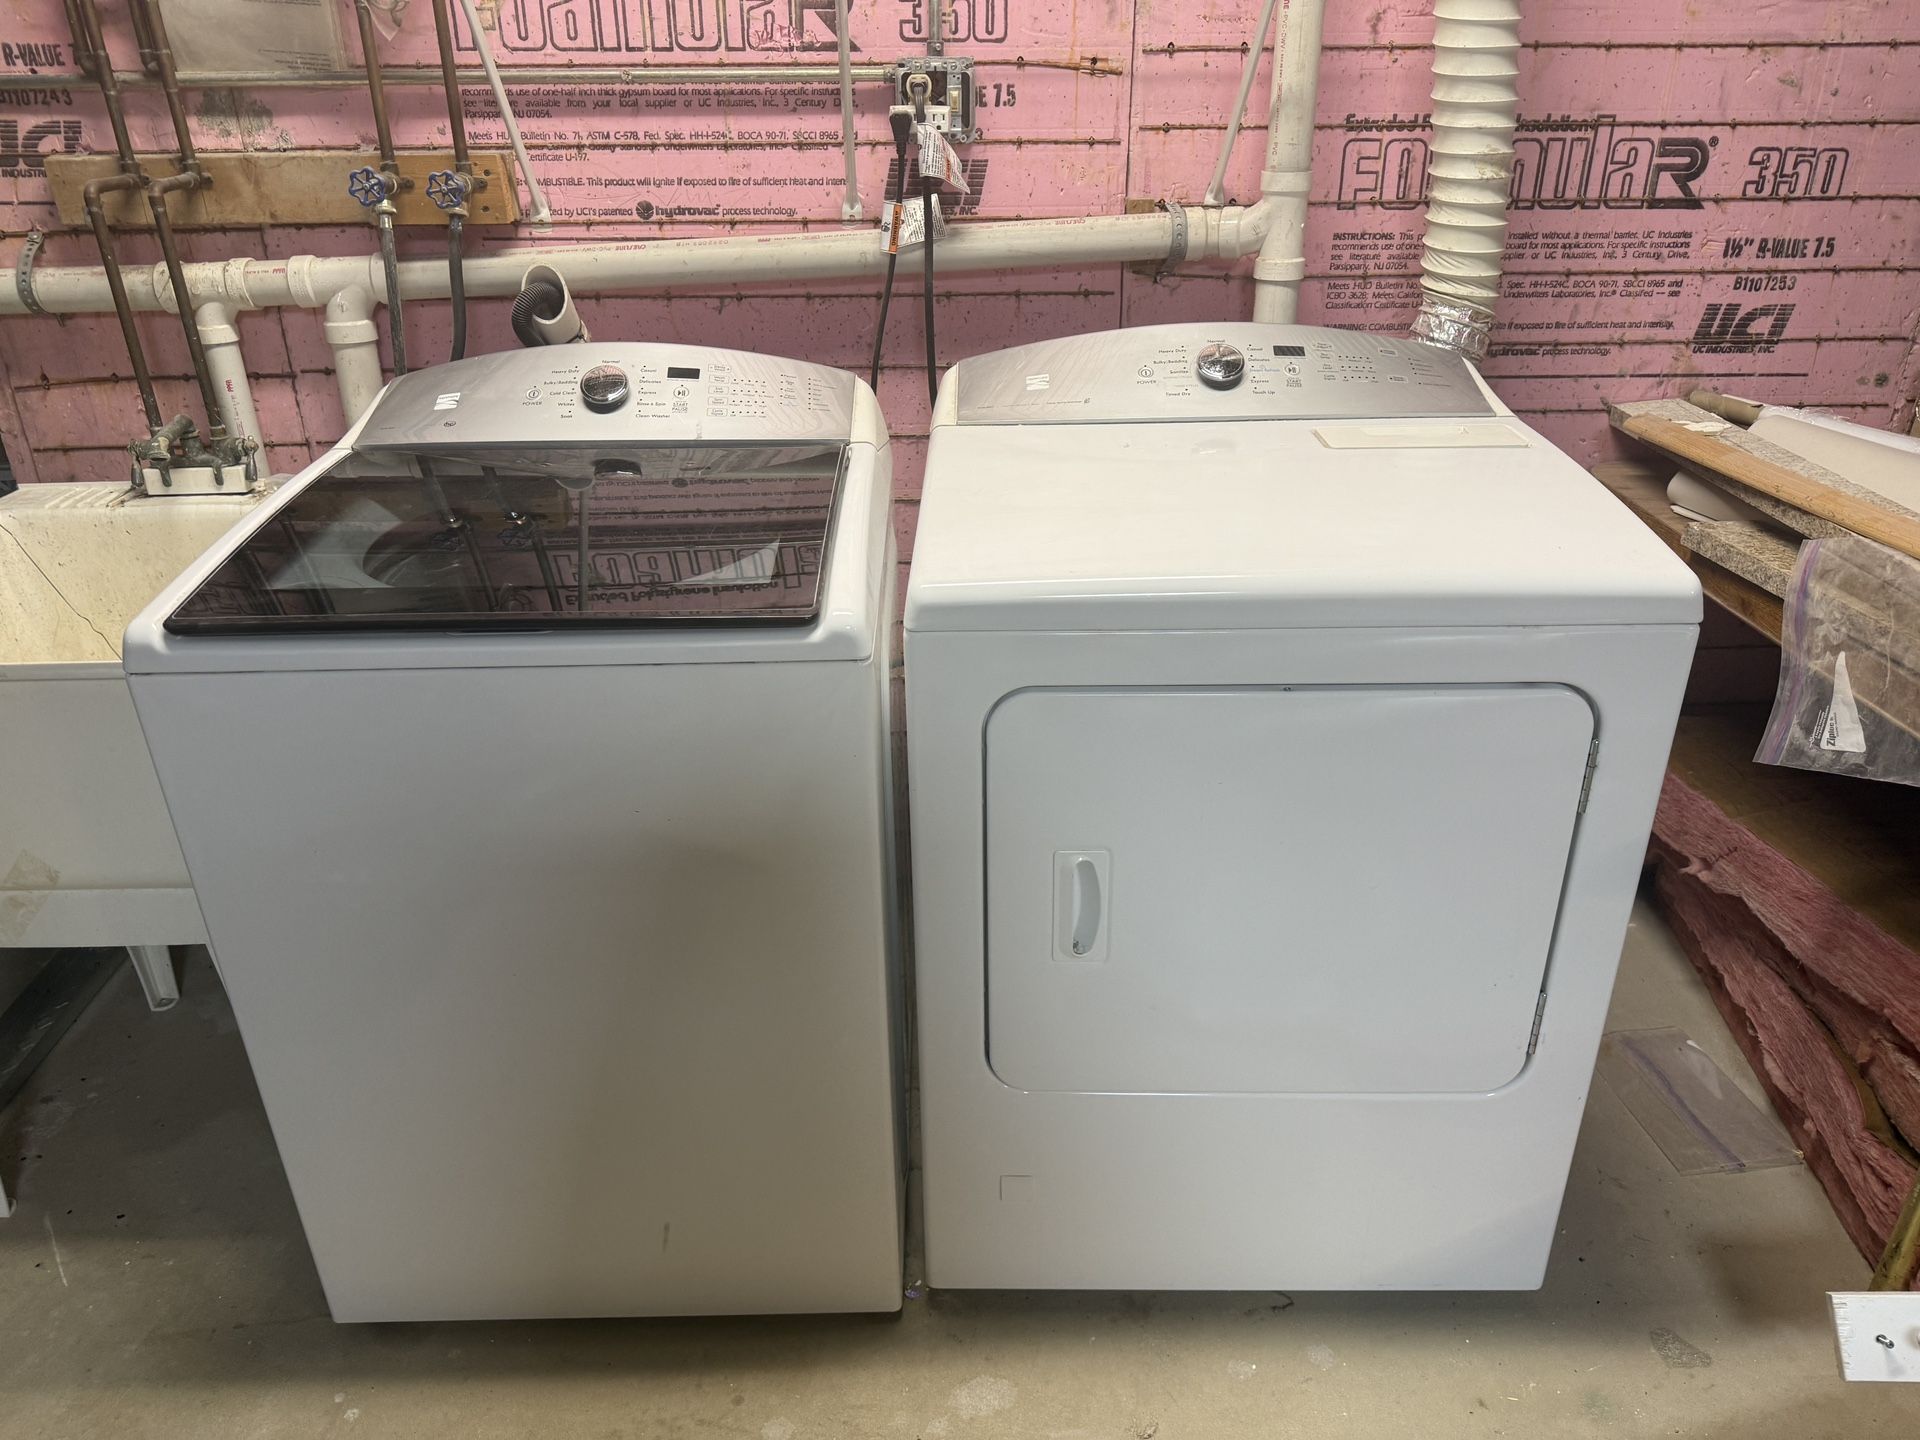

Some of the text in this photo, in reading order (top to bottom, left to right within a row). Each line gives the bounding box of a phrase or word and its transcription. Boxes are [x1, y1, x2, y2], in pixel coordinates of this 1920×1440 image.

[3, 39, 65, 67] R-VALUE
[462, 88, 808, 98] recommds use of one-half inch thick gypsum board for most applications. For specific
[993, 83, 1016, 107] 7.5
[464, 100, 476, 108] see
[526, 99, 560, 108] available
[567, 99, 586, 108] from
[593, 101, 611, 109] your
[620, 99, 638, 108] local
[645, 99, 676, 109] supplier
[699, 99, 711, 108] UC
[717, 99, 757, 108] Industries,
[784, 99, 789, 108] 3
[795, 99, 827, 109] Century
[513, 110, 552, 118] NJ 07054.
[468, 131, 838, 142] Meets HU Bulletin No. ASTM C-578, Fed. Spec. BOCA 8965
[566, 153, 589, 162] U-197.
[1742, 146, 1849, 199] 350
[587, 178, 824, 188] This product will ignite if exposed to fire of sufficient heat and
[564, 207, 574, 219] by
[576, 207, 596, 216] UCI's
[599, 207, 632, 218] patented
[723, 208, 751, 218] process
[753, 207, 797, 217] technology.
[1333, 232, 1395, 240] INSTRUCTIONS:
[1400, 232, 1413, 240] This
[1508, 231, 1538, 240] installed
[1542, 231, 1571, 239] without
[1583, 231, 1610, 239] thermal
[1614, 231, 1638, 239] barrier.
[1643, 231, 1655, 239] UC
[1658, 231, 1692, 239] Industries
[1560, 242, 1604, 252] applications.
[1607, 241, 1619, 249] For
[1621, 241, 1647, 252] specific
[1650, 241, 1690, 249] instructions
[1756, 237, 1810, 259] R-VALUE
[1813, 236, 1835, 258] 7.5
[1545, 251, 1556, 259] UC
[1622, 250, 1627, 259] 3
[1633, 250, 1661, 260] Century
[1667, 250, 1689, 259] Drive,
[1374, 262, 1385, 270] NJ
[1386, 262, 1408, 270] 07054.
[1328, 282, 1350, 290] Meets
[1376, 282, 1403, 290] Bulletin
[1507, 280, 1525, 290] Spec.
[1573, 280, 1595, 288] BOCA
[1668, 279, 1683, 287] and
[1733, 275, 1798, 292] B1107253
[1503, 290, 1549, 298] Underwriters
[1325, 301, 1372, 309] Classification
[1507, 321, 1513, 329] if
[1514, 321, 1544, 331] exposed
[1567, 321, 1575, 329] of
[1576, 321, 1608, 329] sufficient
[1692, 303, 1797, 345] UCI
[1542, 346, 1611, 357] process technology.
[1693, 345, 1705, 354] UC
[1826, 721, 1837, 748] Ziploc
